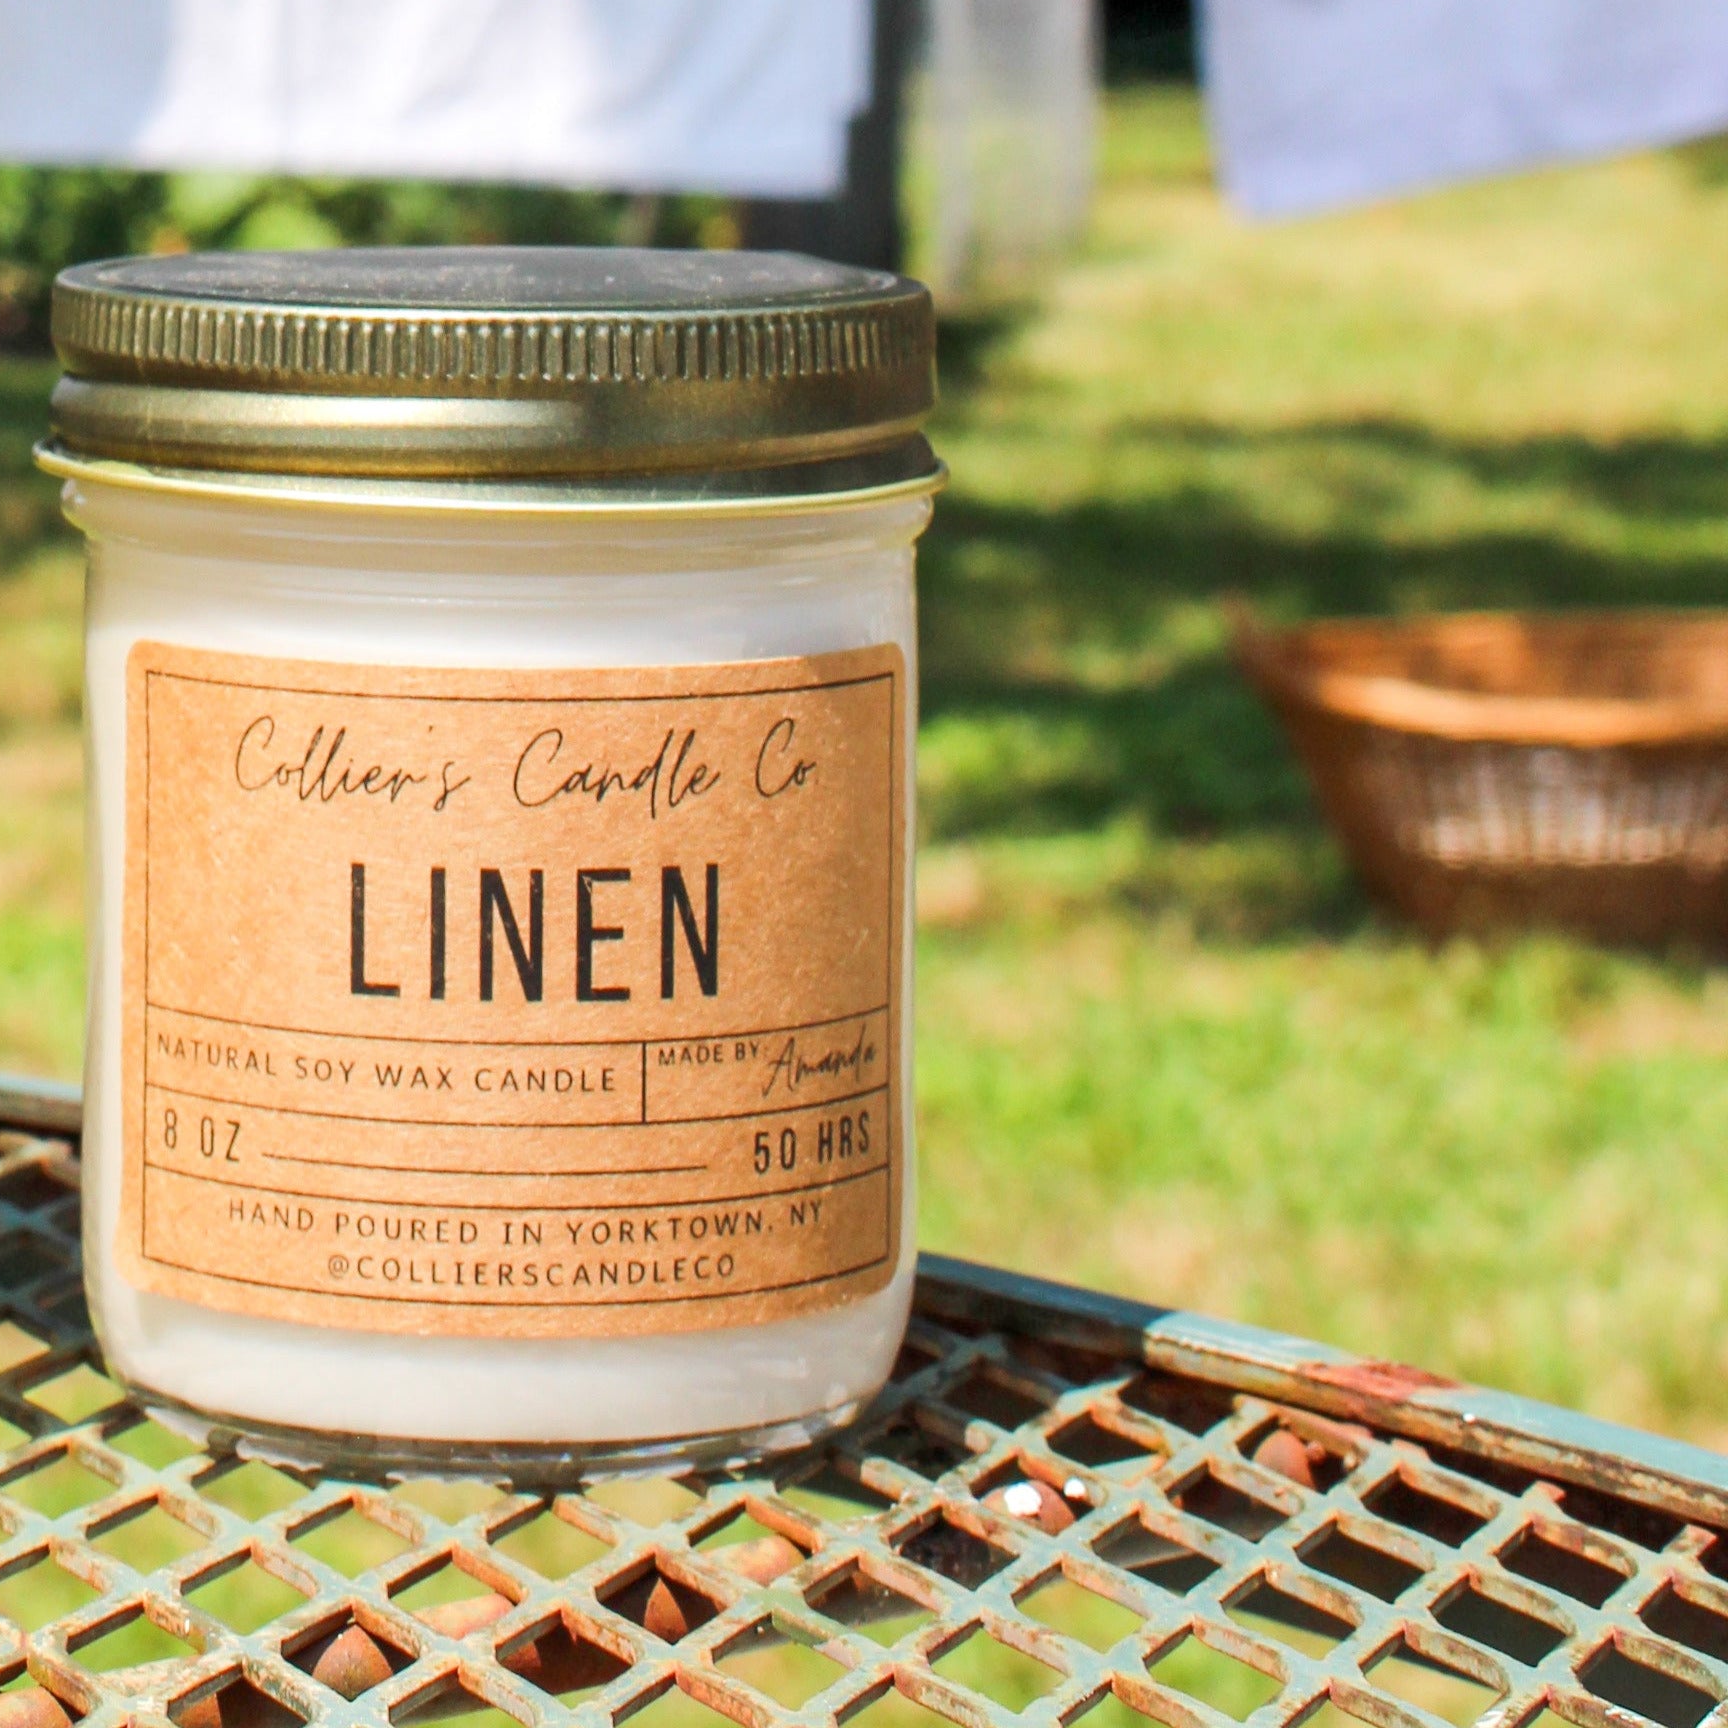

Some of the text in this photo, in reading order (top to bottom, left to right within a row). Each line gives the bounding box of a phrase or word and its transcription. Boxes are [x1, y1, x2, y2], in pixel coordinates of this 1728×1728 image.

[234, 714, 472, 813] Collier's
[512, 727, 722, 821] Candle
[351, 863, 719, 1002] LINEN
[157, 1033, 615, 1093] NATURAL SOY WAX CANDLE
[658, 1043, 724, 1066] MADE
[761, 1024, 877, 1098] Amanda
[164, 1107, 241, 1163] 8 OZ
[753, 1111, 869, 1175] 50 HRS
[229, 1198, 315, 1232] HAND
[335, 1211, 479, 1244] POURED
[502, 1221, 543, 1246] IN
[790, 1199, 822, 1227] NY
[327, 1252, 735, 1288] @COLLIERSCANDLECO
